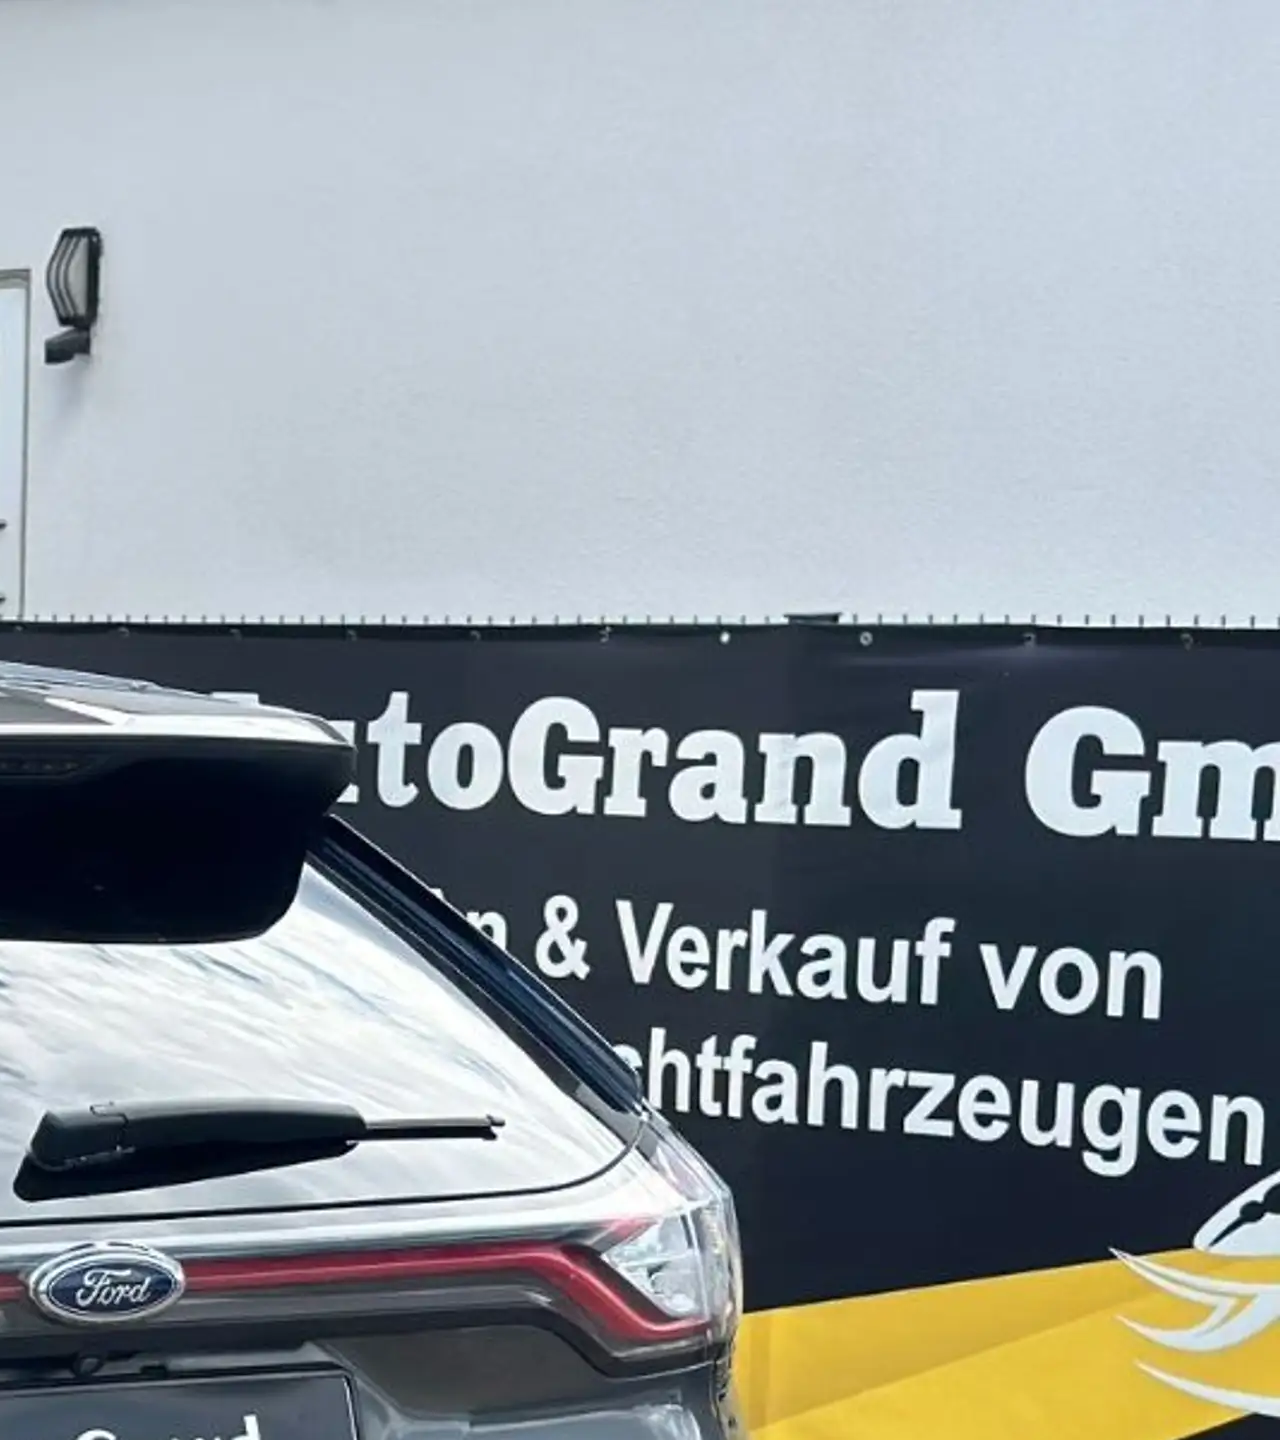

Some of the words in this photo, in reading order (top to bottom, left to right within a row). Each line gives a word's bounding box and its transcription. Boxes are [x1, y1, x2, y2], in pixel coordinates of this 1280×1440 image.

[328, 690, 962, 831] toGrand
[536, 895, 590, 980] &
[616, 900, 955, 1004] Verkauf
[980, 944, 1161, 1019] von
[75, 1268, 152, 1307] Ford
